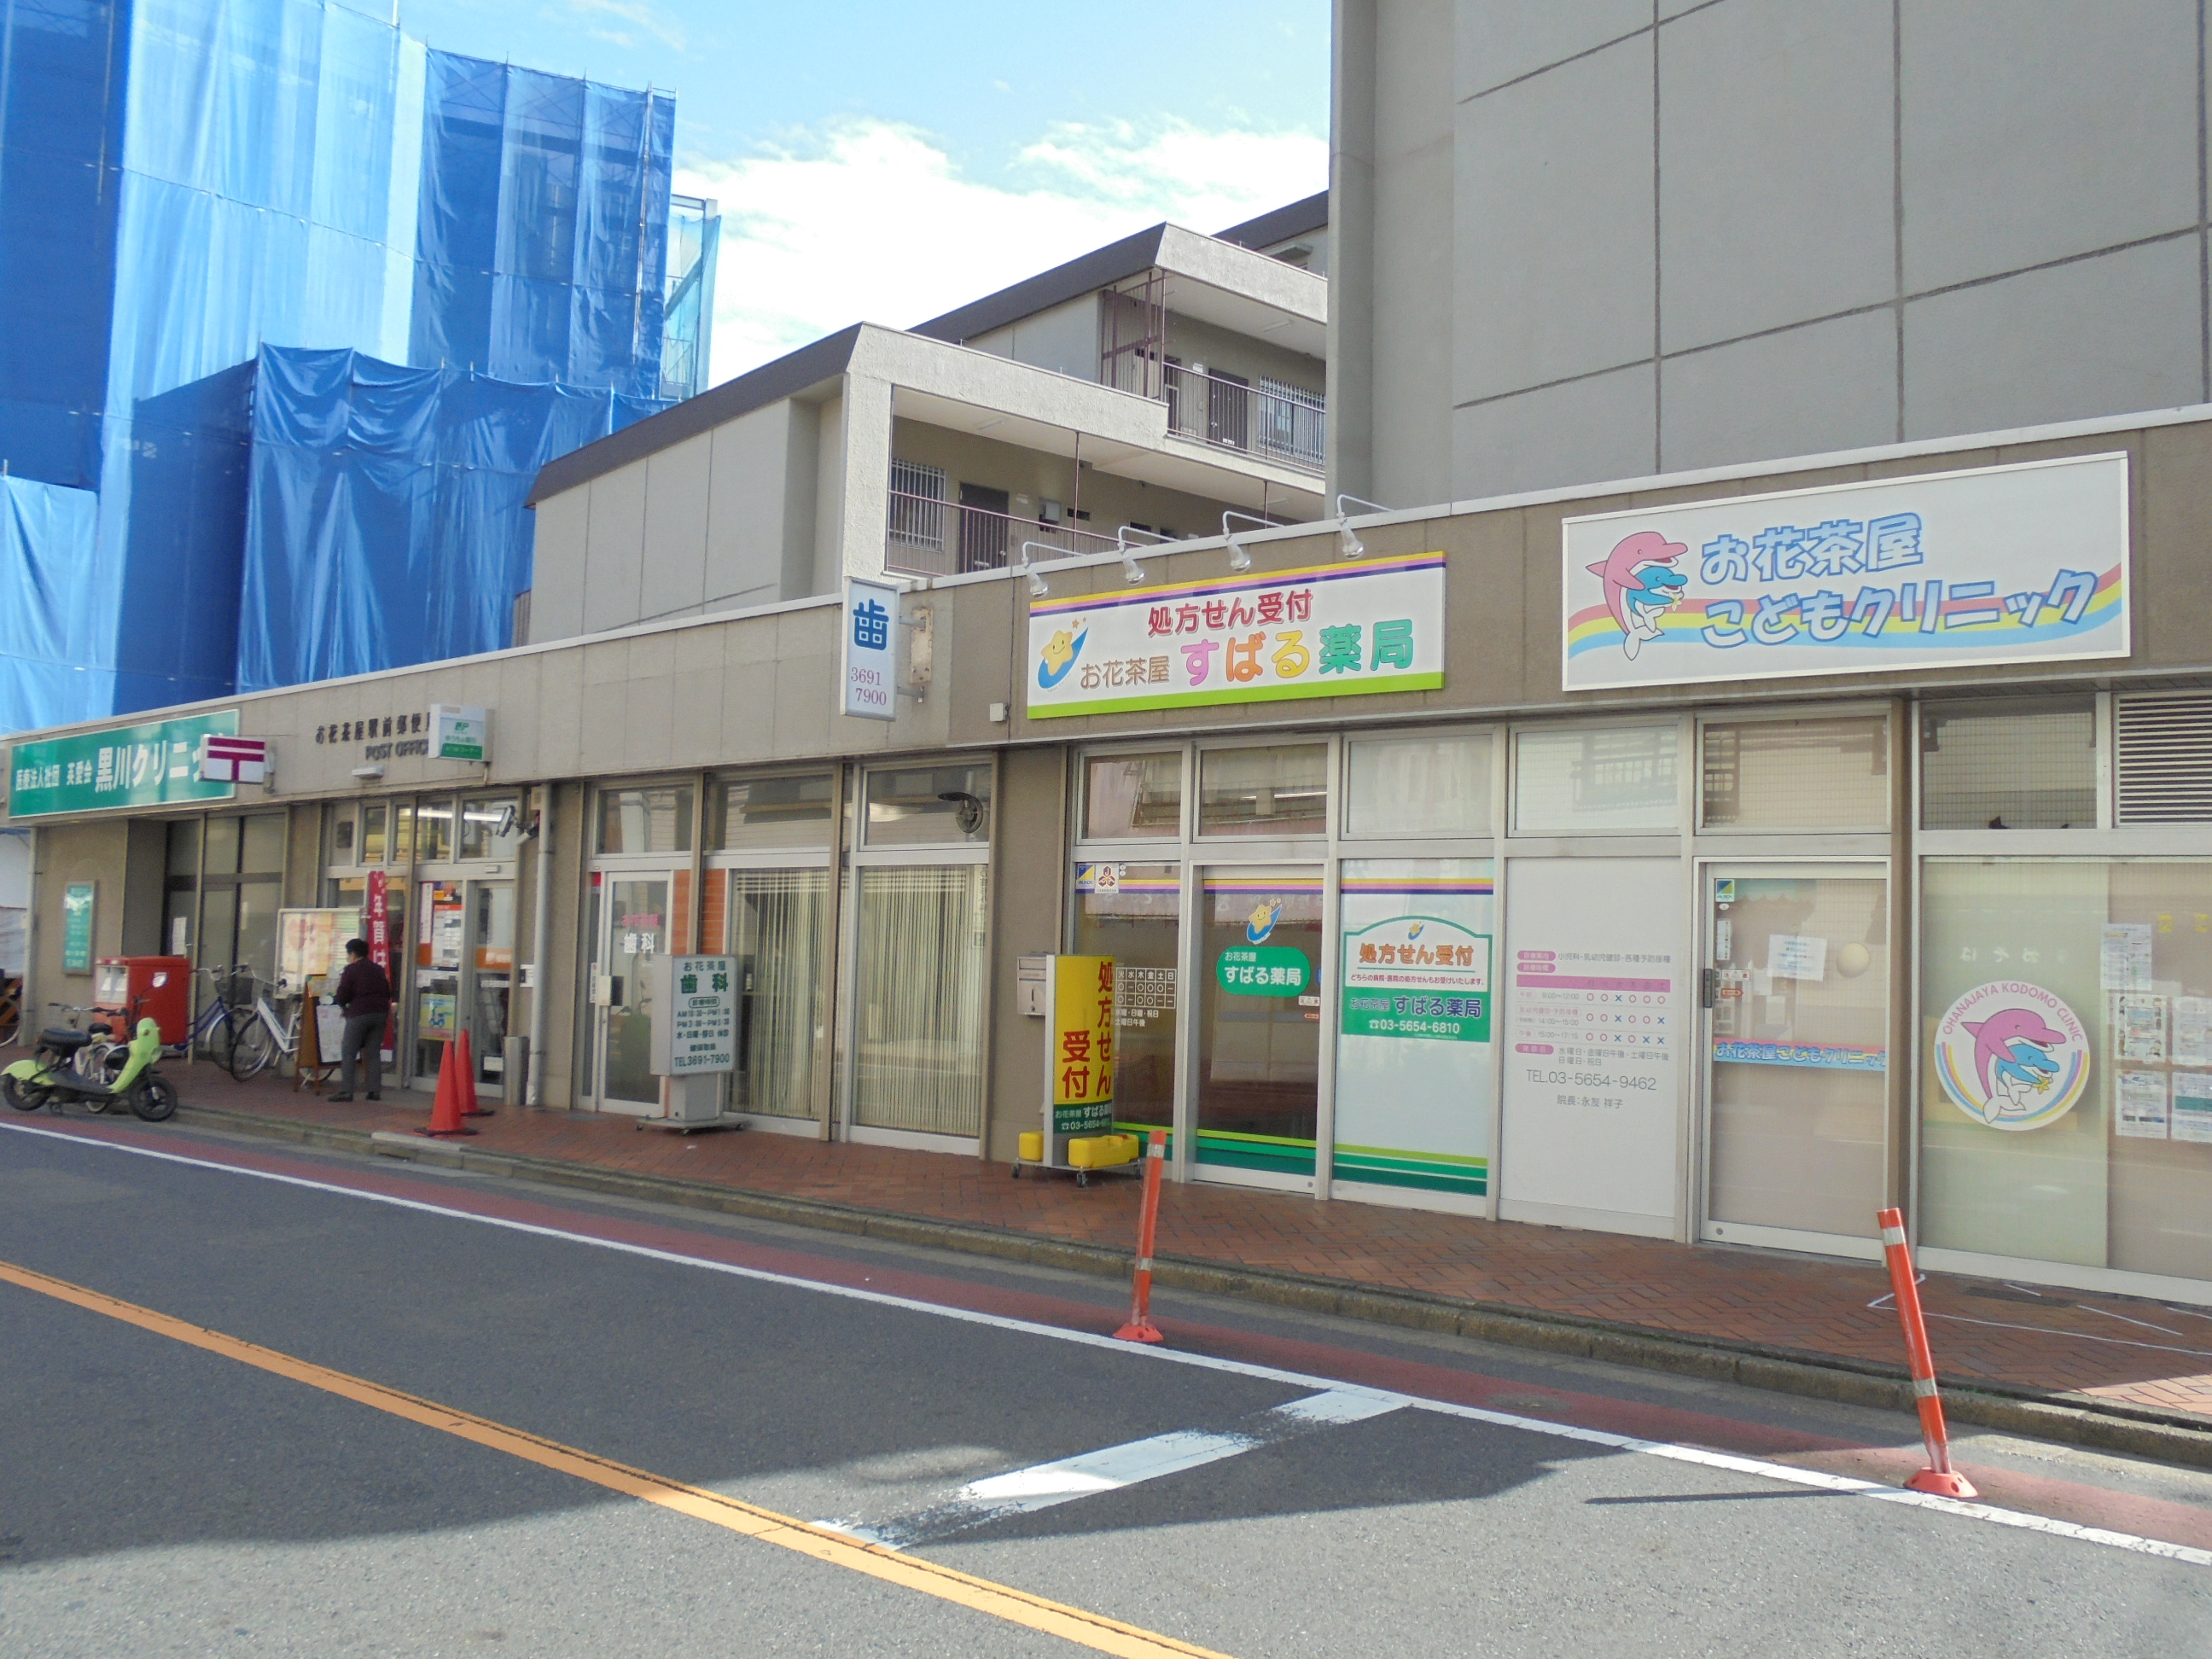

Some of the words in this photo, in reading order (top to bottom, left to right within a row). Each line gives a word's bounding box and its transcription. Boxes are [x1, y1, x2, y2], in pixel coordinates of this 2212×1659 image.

[1699, 511, 1924, 585] お花茶屋
[1148, 589, 1314, 637] 処方せん受付
[1700, 568, 2099, 649] こどもクリニック
[853, 598, 889, 651] 歯
[1080, 655, 1171, 690] お花茶屋
[1180, 619, 1414, 687] すばる薬局
[851, 667, 881, 686] 3691
[855, 687, 887, 706] 7900
[316, 712, 430, 744] お花茶屋駅前郵便
[365, 743, 393, 761] POST
[395, 738, 428, 758] OFFIC
[95, 739, 203, 794] 黒川クリニ
[1225, 952, 1257, 962] お花茶屋
[1359, 942, 1474, 966] 処方せん受付
[684, 961, 726, 972] お花茶屋
[1224, 965, 1301, 987] すばる薬局
[1350, 998, 1390, 1010] お花茶屋
[1394, 996, 1481, 1018] すばる薬局
[1943, 984, 1999, 1035] OHANAJAYA
[2001, 982, 2058, 1010] KODOMO
[2057, 1006, 2083, 1043] CLINIC
[1380, 1019, 1461, 1034] 03-5654-6810
[1062, 1030, 1090, 1099] 受付
[1526, 1069, 1657, 1091] TEL.03-5654-9462
